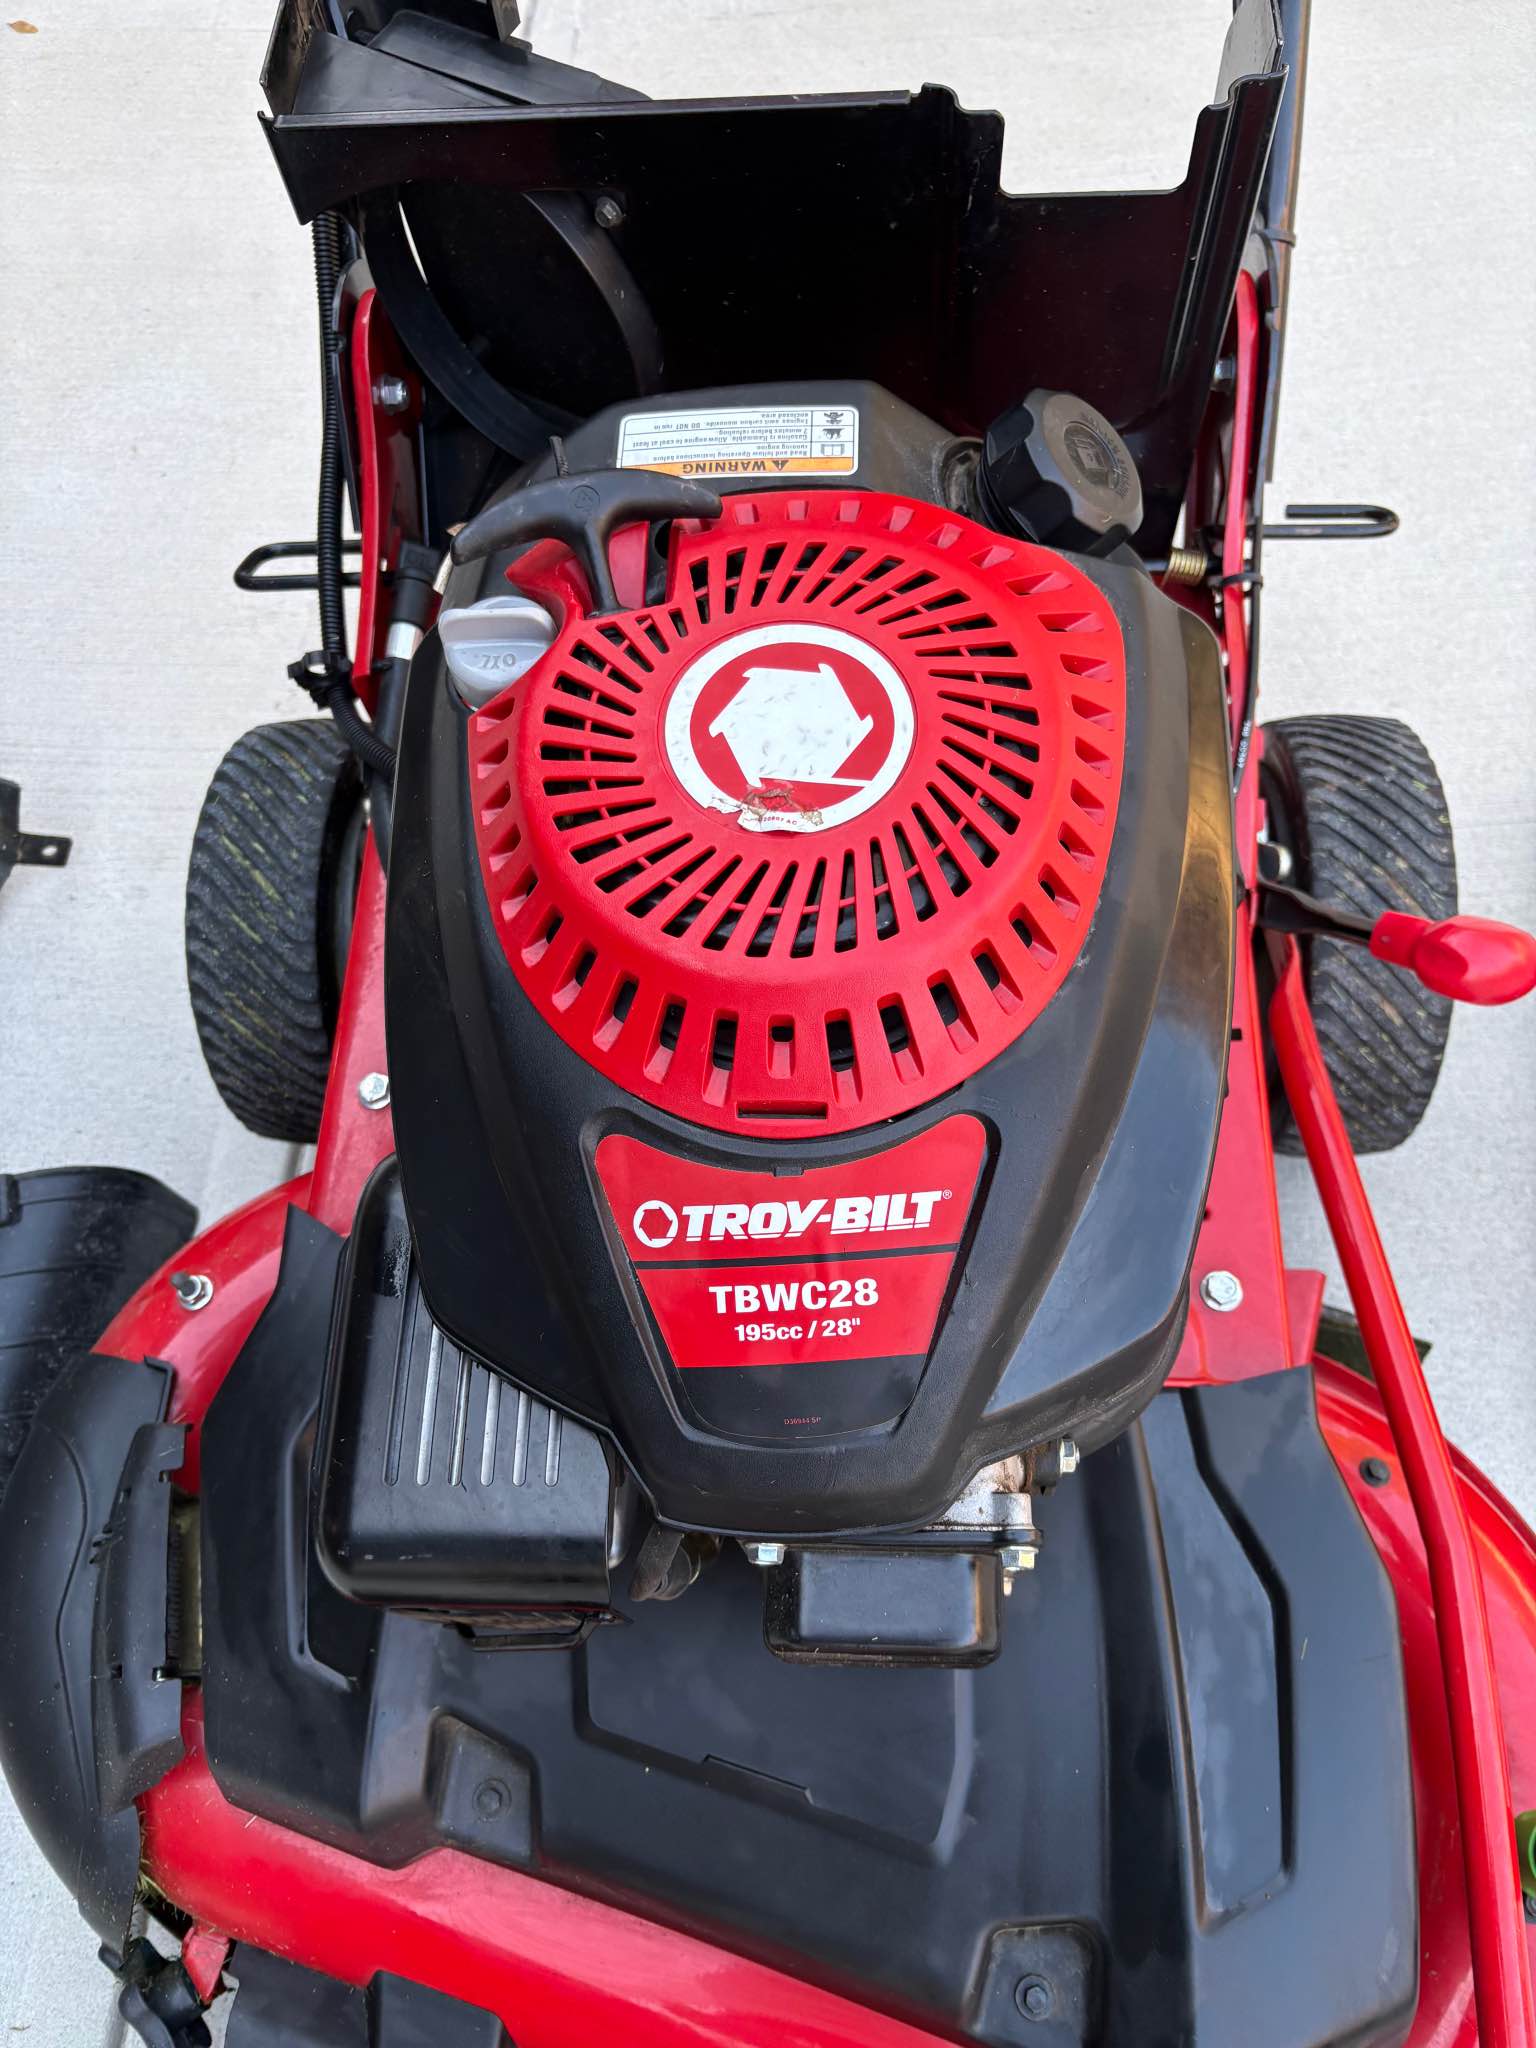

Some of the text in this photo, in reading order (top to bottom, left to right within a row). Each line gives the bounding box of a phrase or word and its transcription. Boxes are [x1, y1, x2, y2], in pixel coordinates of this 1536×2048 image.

[682, 460, 766, 474] WARNING
[478, 653, 517, 670] OIL
[682, 1190, 942, 1241] TROY-BILT
[709, 1278, 879, 1314] TBWC28
[735, 1317, 861, 1342] 195cc / 28"
